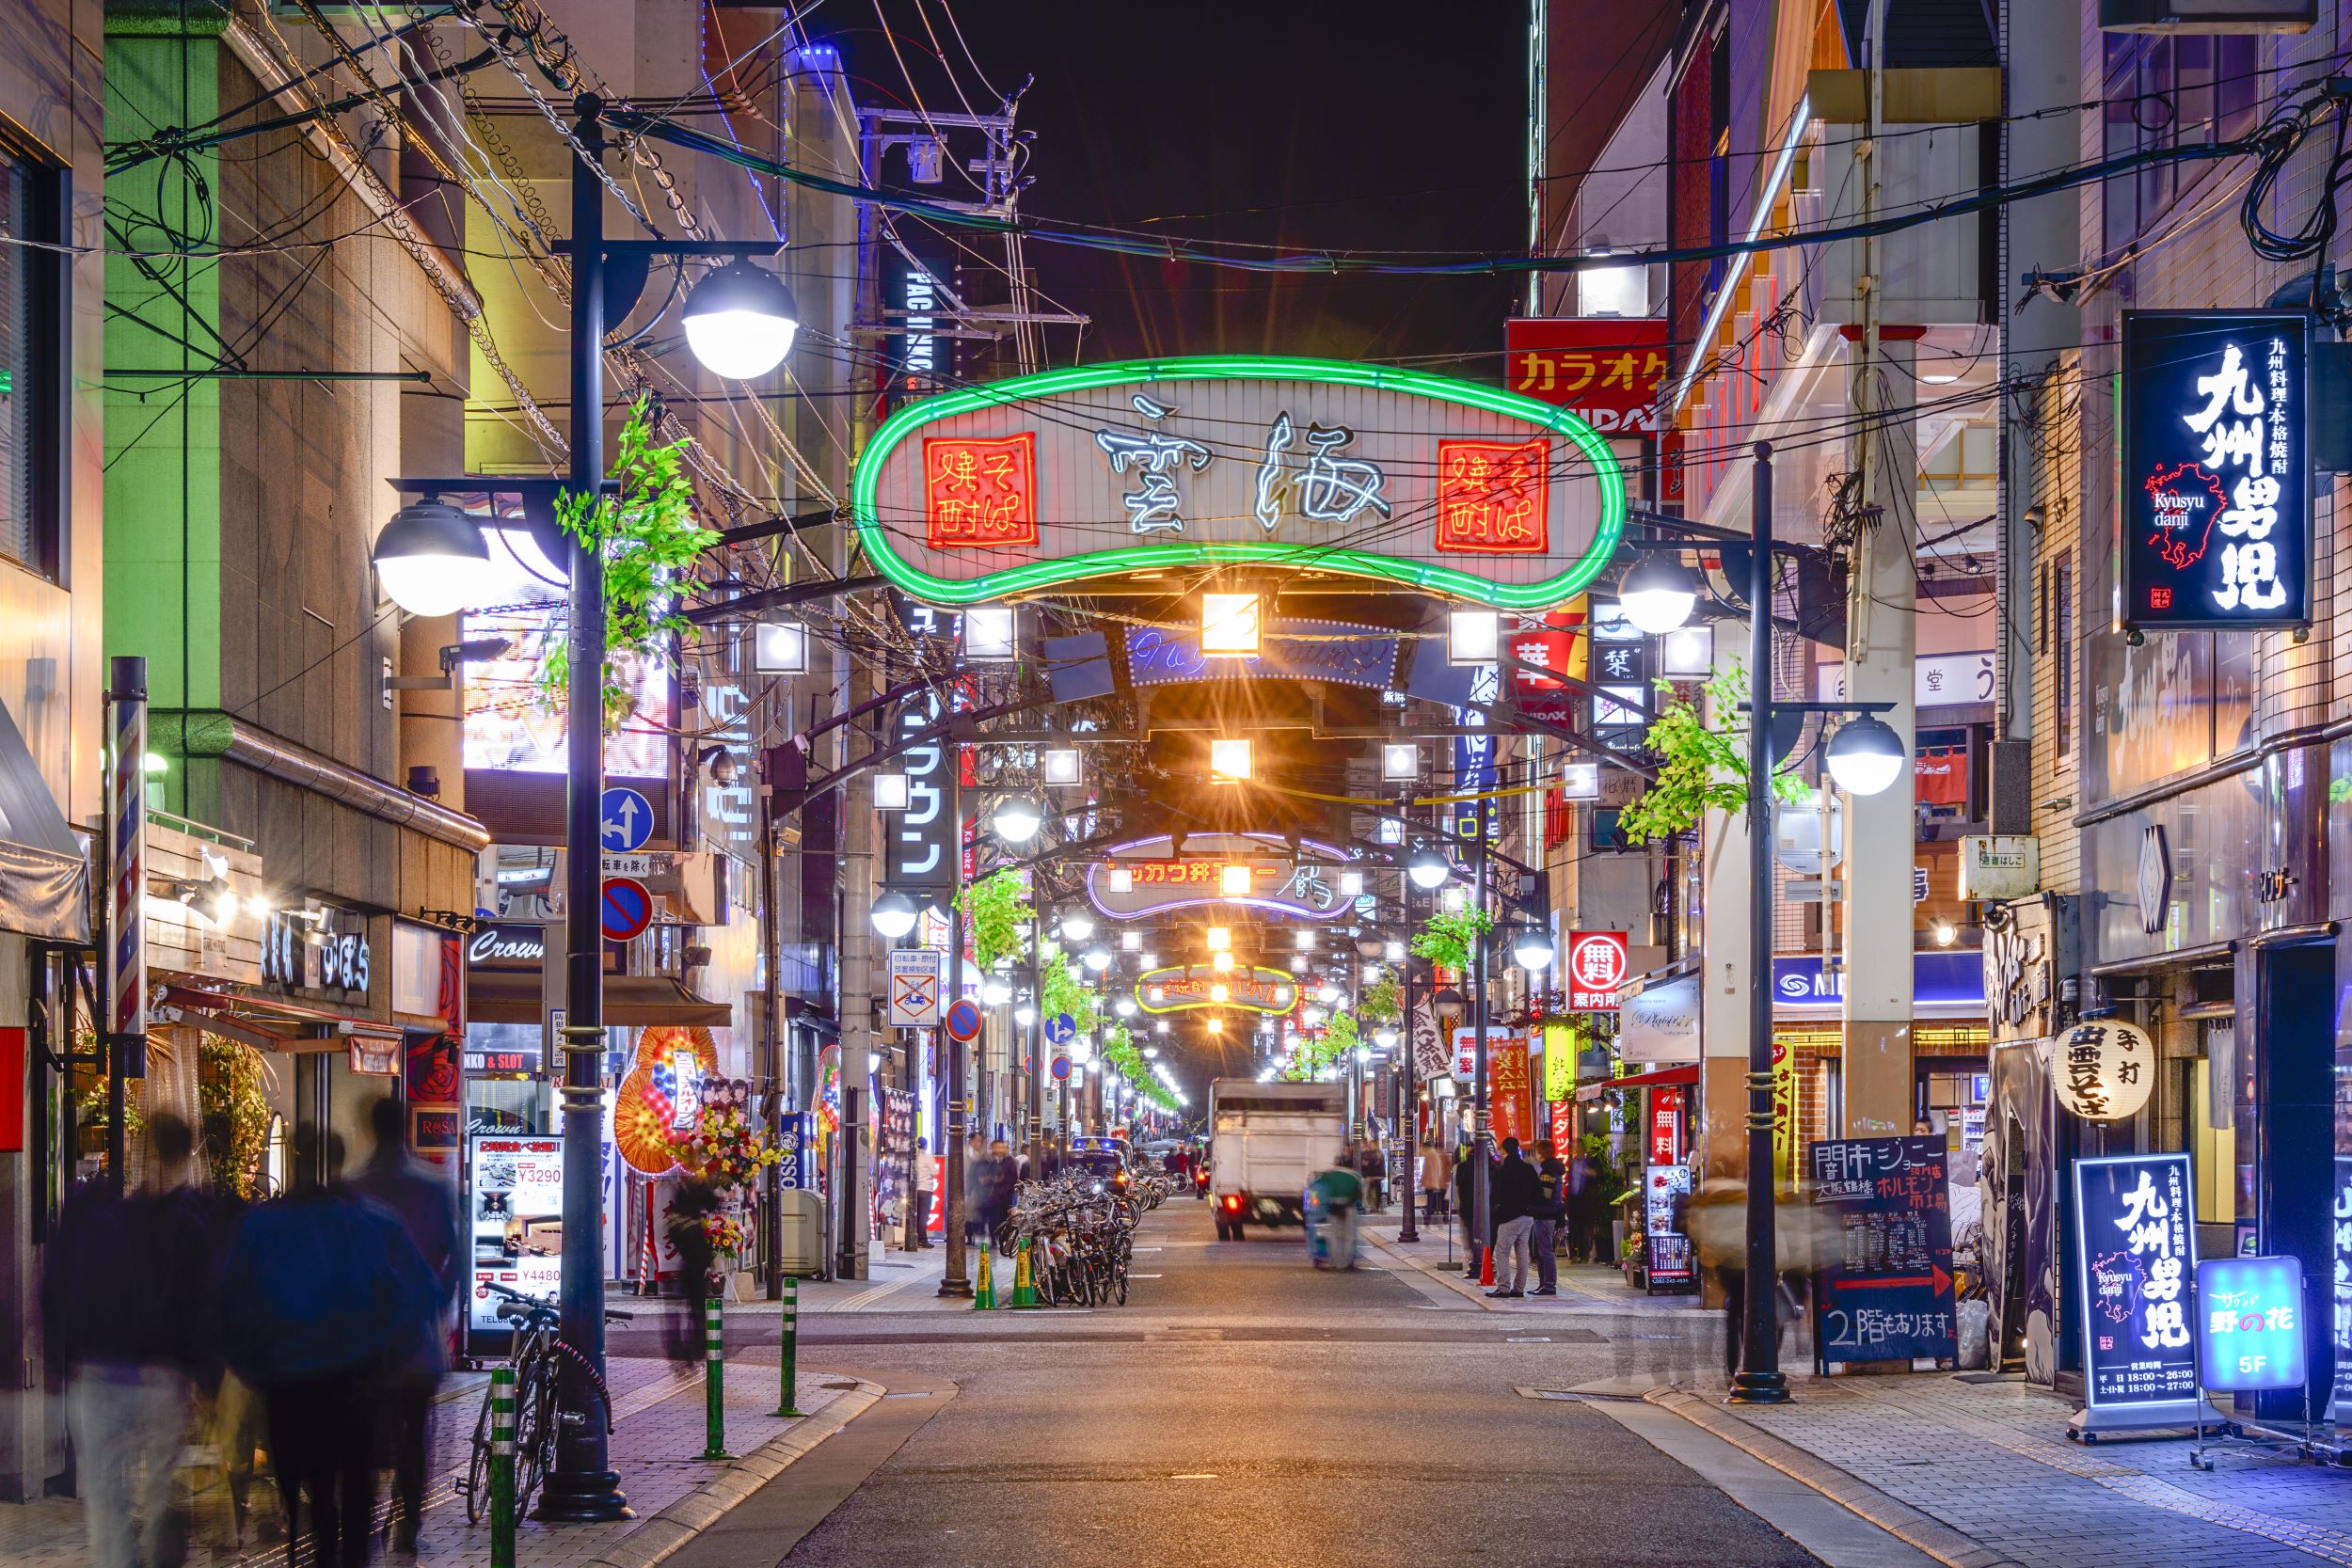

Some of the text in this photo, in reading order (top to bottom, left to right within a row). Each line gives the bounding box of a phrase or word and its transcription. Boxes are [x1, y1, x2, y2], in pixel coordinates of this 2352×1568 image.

[1518, 353, 1666, 390] カラオケ
[2268, 339, 2288, 474] 九州料理・本格焼酎
[2183, 343, 2286, 610] 九州男児
[2154, 493, 2203, 511] Kyusyu
[2154, 512, 2188, 528] danji
[1927, 669, 1943, 691] 堂
[602, 859, 646, 872] 転車を除く
[1583, 943, 1614, 981] 無料
[498, 1054, 523, 1069] SLOT
[2117, 1029, 2140, 1085] 手打
[2067, 1026, 2109, 1116] 出雲そば
[469, 1118, 522, 1134] Crown
[1656, 1109, 1673, 1155] 無料
[519, 1170, 561, 1182] ¥3290
[1819, 1181, 1873, 1197] 大阪鶴橋
[2169, 1165, 2185, 1256] 九州料理・本格焼酎
[2114, 1171, 2190, 1349] 九州男児
[2098, 1272, 2132, 1284] Kyusyu
[2099, 1284, 2122, 1295] danji
[1828, 1309, 1949, 1346] 2階もあります
[2209, 1307, 2295, 1334] 野の花
[2131, 1361, 2162, 1370] 営業時間
[2239, 1355, 2267, 1373] 5F
